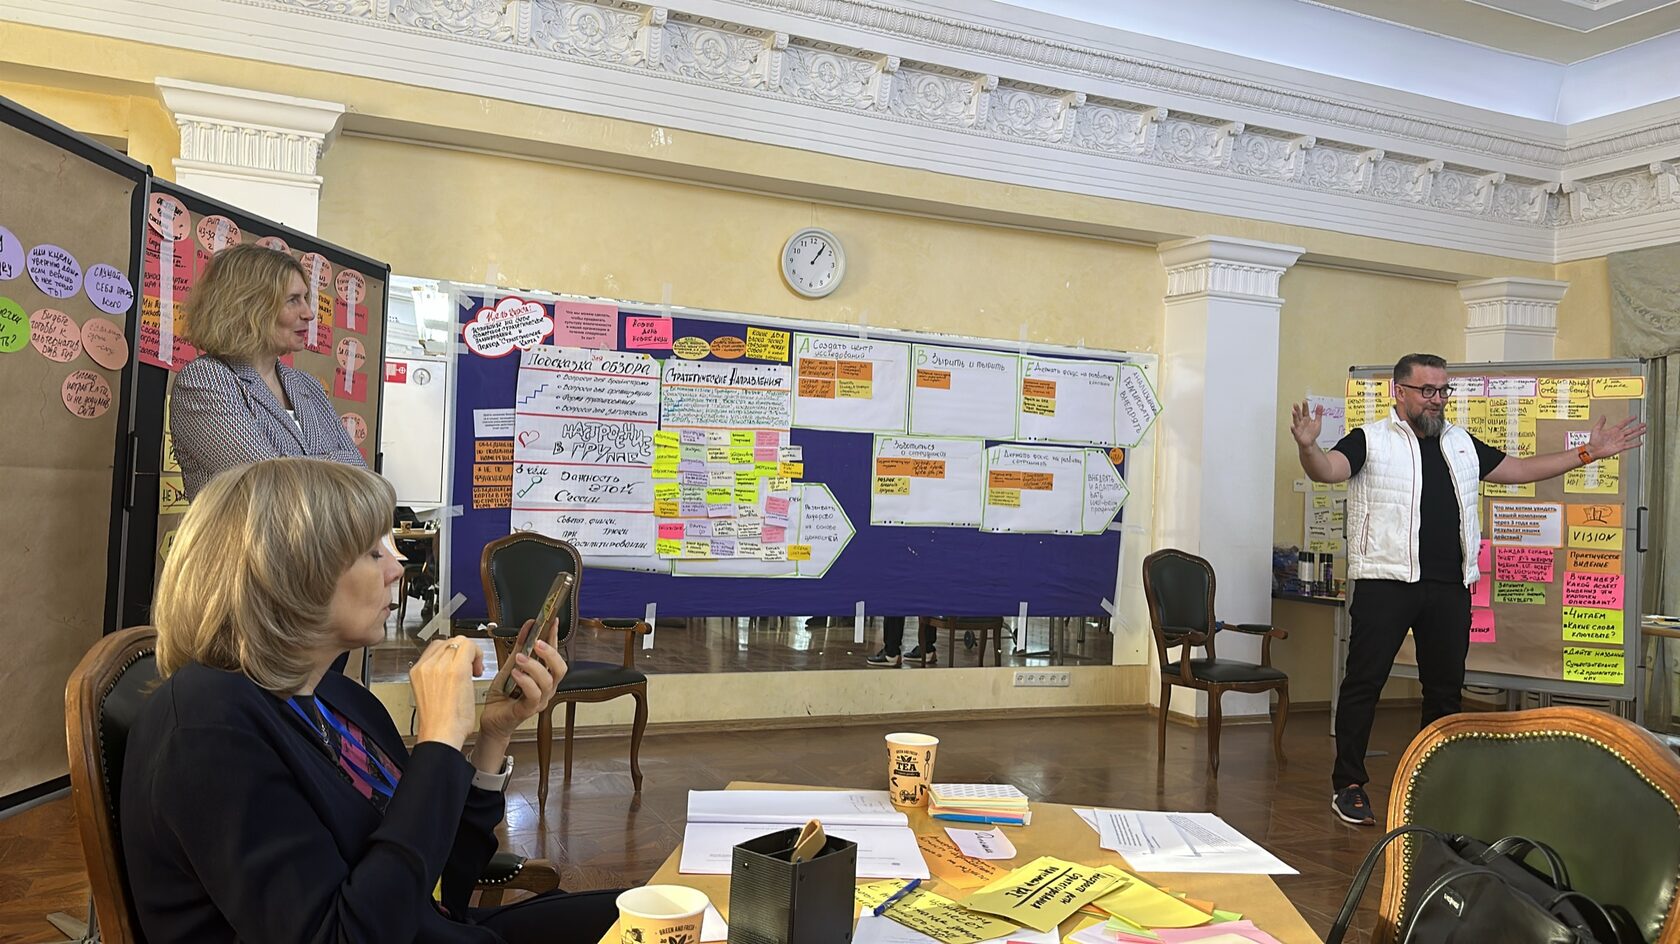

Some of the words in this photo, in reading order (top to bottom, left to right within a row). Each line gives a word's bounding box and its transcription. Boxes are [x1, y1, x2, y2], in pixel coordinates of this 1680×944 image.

[813, 340, 847, 350] Создать
[851, 344, 873, 352] центр
[528, 354, 592, 371] Подсказка
[1573, 532, 1616, 542] VISION
[1568, 621, 1590, 630] КАКИЕ
[896, 762, 916, 771] TEA
